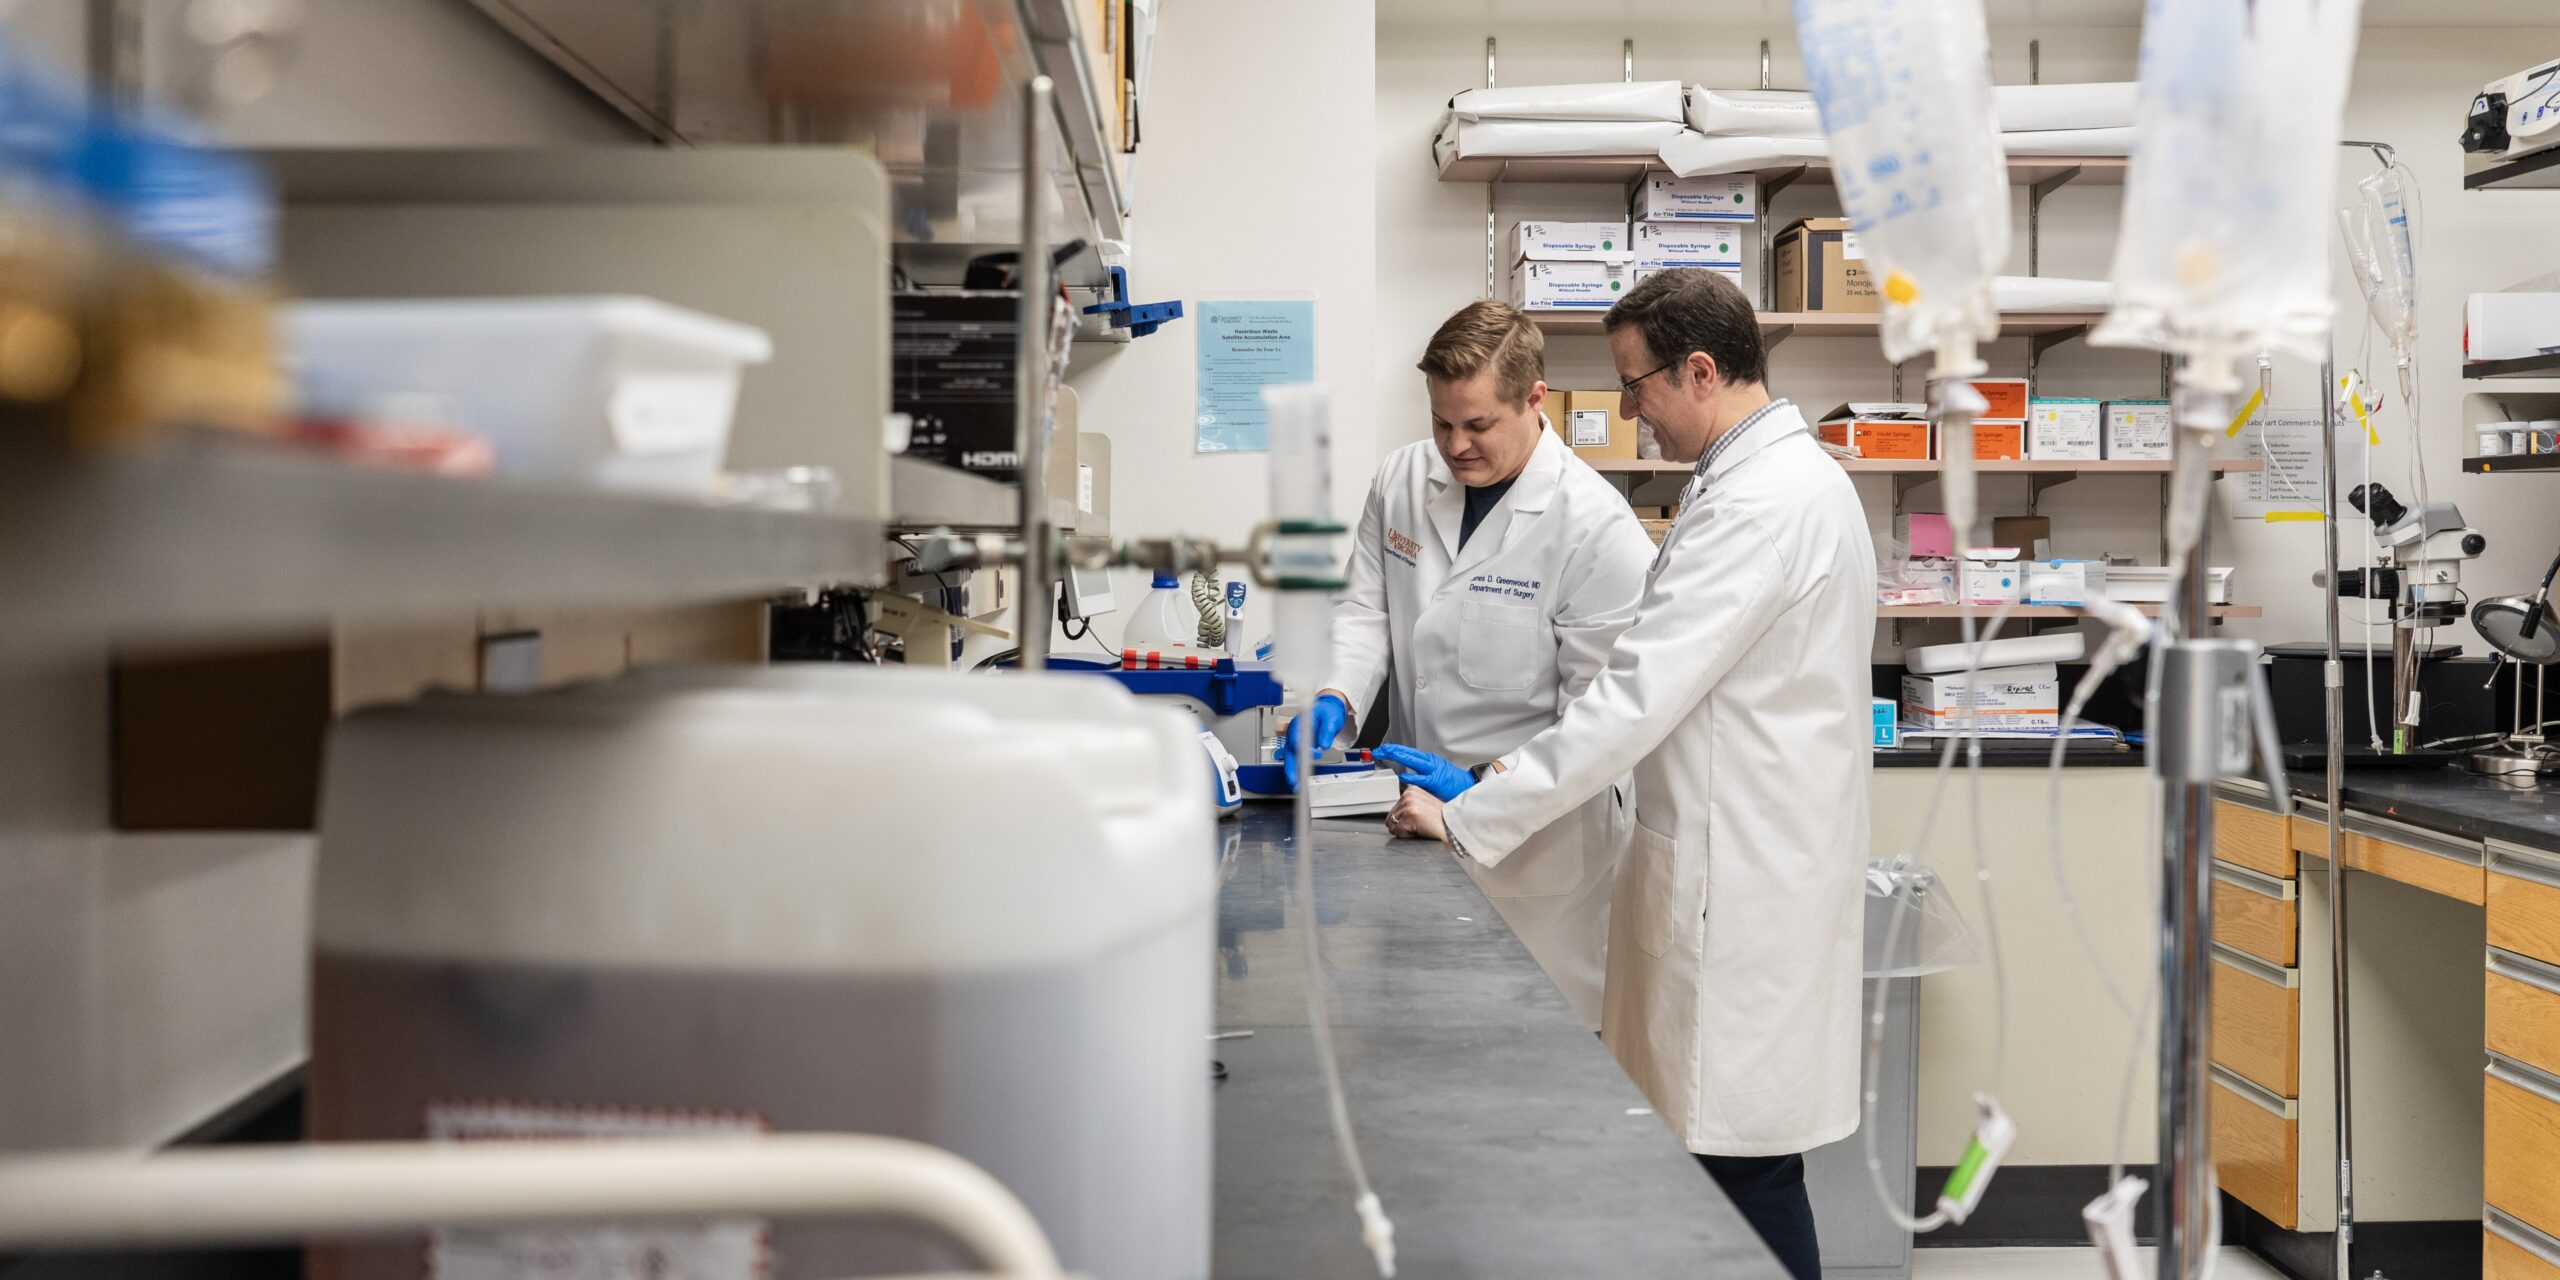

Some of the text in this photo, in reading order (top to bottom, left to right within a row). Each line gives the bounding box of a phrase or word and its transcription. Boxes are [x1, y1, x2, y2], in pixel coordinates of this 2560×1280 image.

[1671, 193, 1702, 201] Disposable
[1523, 224, 1532, 238] 1
[1640, 225, 1647, 239] 1
[1529, 264, 1537, 277] 1
[1846, 279, 1873, 289] Monoje
[961, 450, 1019, 467] HDM
[1388, 527, 1424, 553] UNIVERSITY
[1487, 575, 1493, 583] D.
[1532, 581, 1541, 589] MD
[1469, 583, 1502, 595] Department
[1513, 588, 1535, 600] Surgery
[1881, 727, 1889, 739] L
